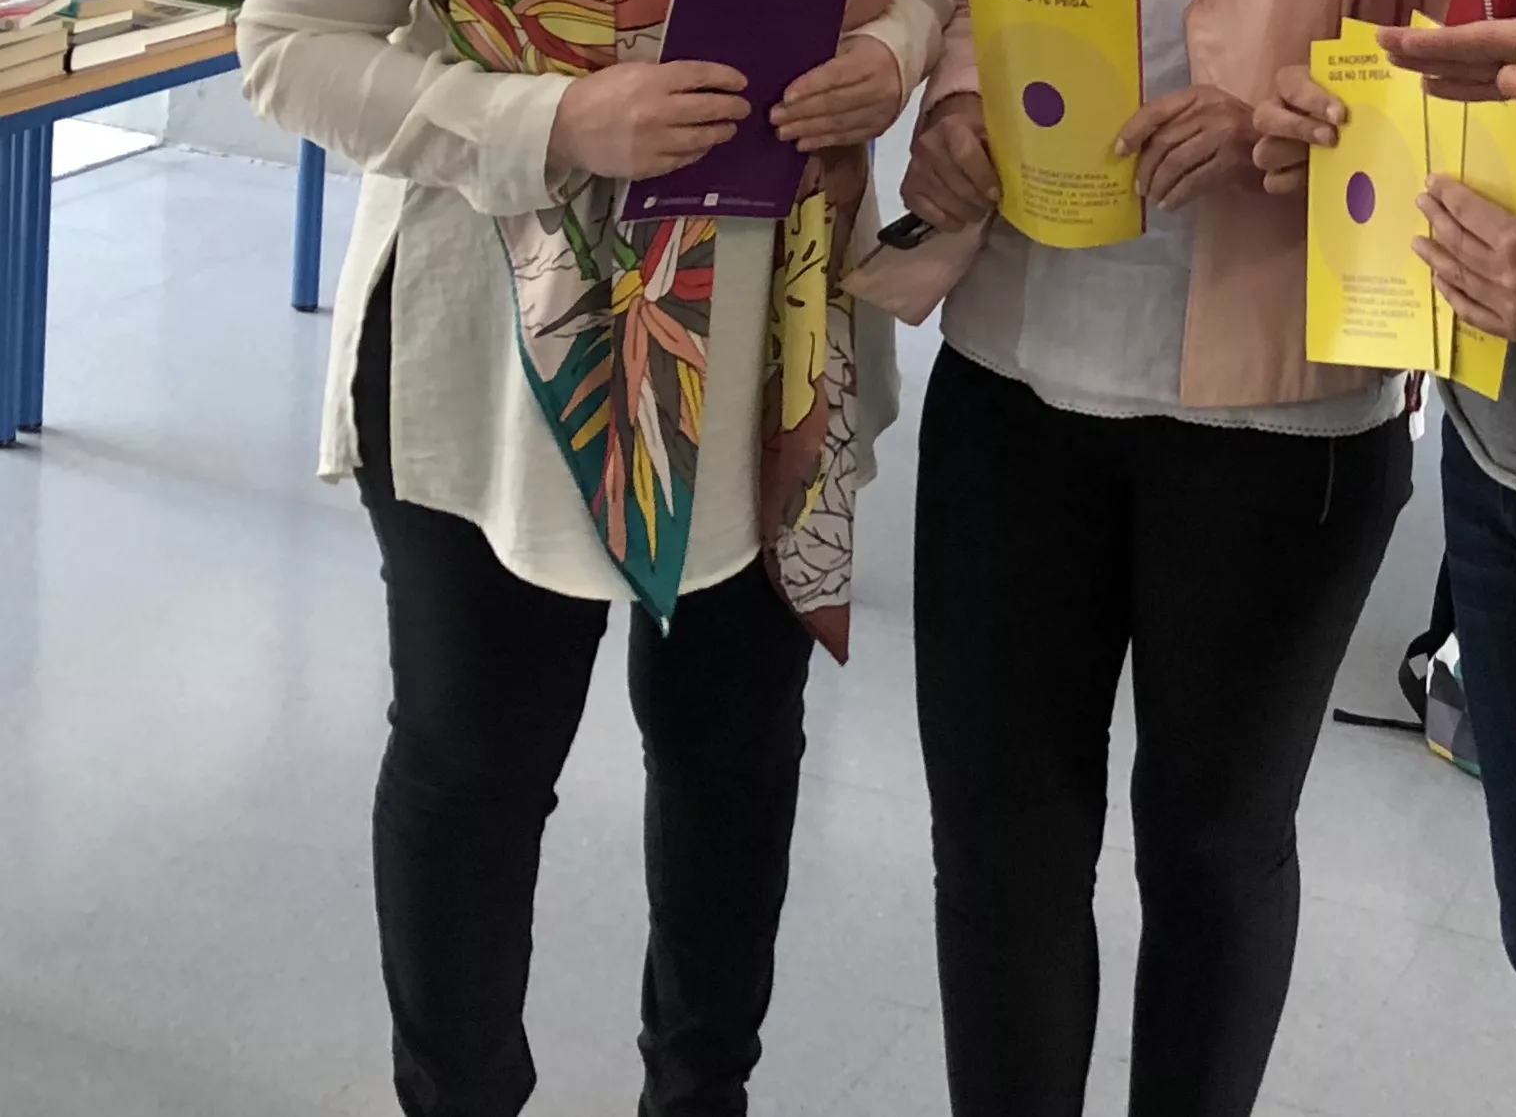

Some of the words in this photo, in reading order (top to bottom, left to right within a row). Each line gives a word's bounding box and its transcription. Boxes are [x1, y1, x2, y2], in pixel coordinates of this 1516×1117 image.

[1328, 54, 1336, 66] EL
[1328, 70, 1343, 81] QUE
[1345, 70, 1357, 81] NO
[1358, 70, 1367, 81] TE
